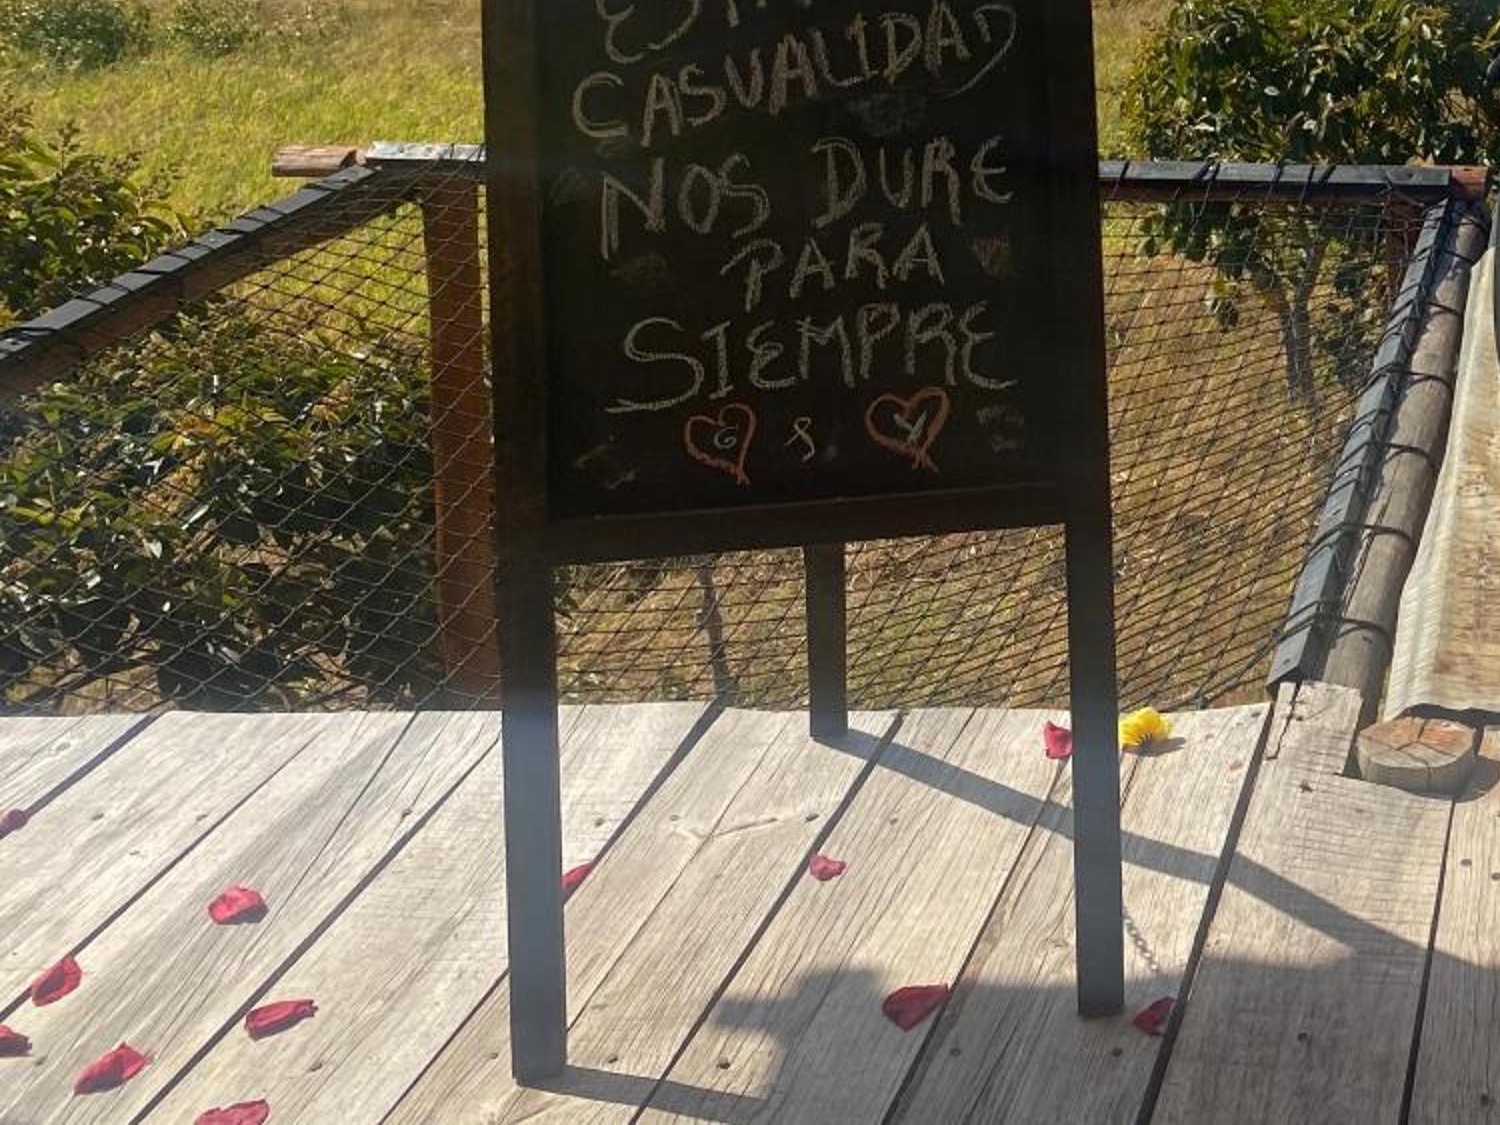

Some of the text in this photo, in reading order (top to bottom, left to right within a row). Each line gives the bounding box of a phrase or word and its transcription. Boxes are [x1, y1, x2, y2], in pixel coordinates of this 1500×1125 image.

[602, 135, 1013, 261] NOS DURE
[719, 221, 945, 312] PARA
[604, 300, 1018, 414] SIEMPRE
